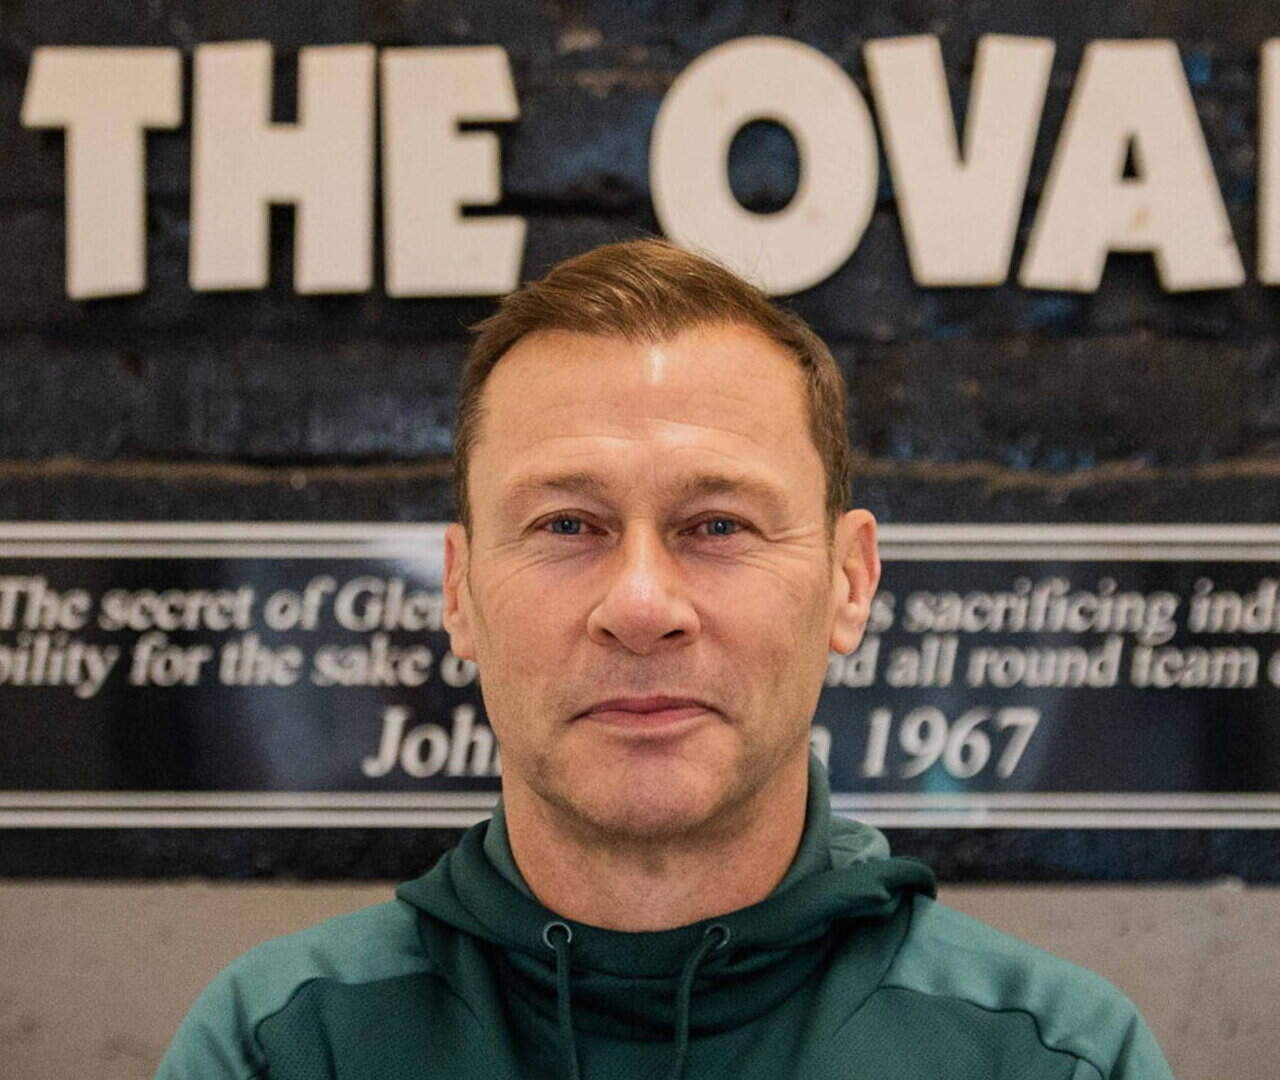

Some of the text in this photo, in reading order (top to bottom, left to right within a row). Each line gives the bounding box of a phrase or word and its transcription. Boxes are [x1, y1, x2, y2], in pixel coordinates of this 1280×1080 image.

[22, 40, 526, 299] THE
[98, 584, 255, 631] secret
[264, 574, 337, 631] of
[903, 576, 1179, 646] sacrificing
[128, 630, 213, 687] for
[220, 631, 302, 687] the
[311, 632, 433, 687] sake
[886, 634, 959, 688] all
[967, 634, 1124, 688] round
[1130, 645, 1259, 688] team
[860, 705, 1042, 779] 1967
